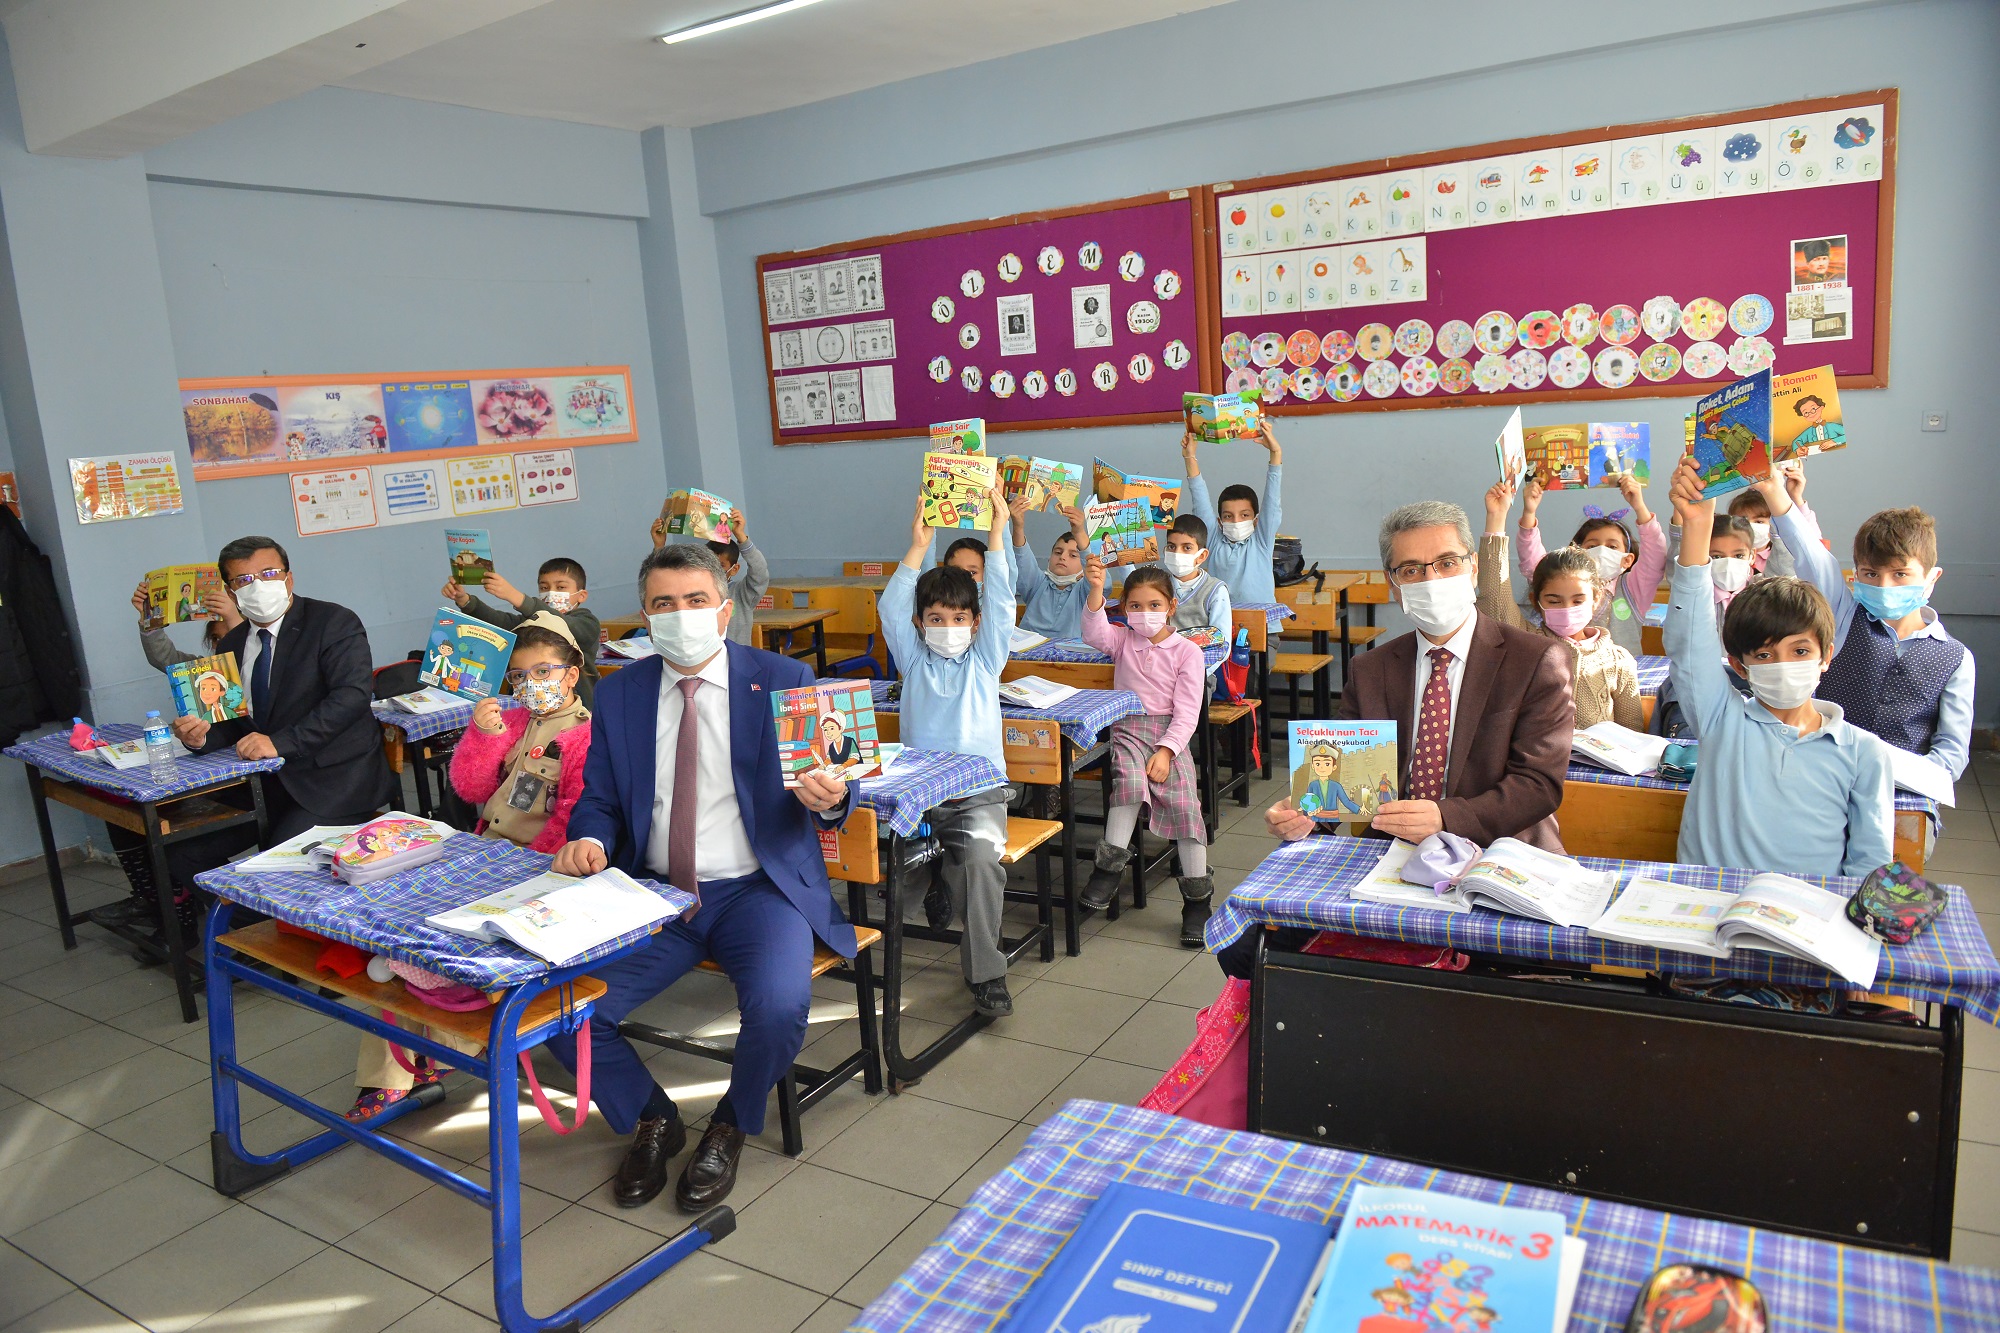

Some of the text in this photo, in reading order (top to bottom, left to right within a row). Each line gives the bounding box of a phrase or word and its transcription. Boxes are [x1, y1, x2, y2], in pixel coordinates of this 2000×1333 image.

[1778, 161, 1814, 177] Ö ö
[1836, 157, 1871, 171] R r
[1671, 173, 1704, 191] Ü ü
[1724, 170, 1758, 185] Y y
[1571, 188, 1602, 202] U u
[1620, 182, 1652, 196] T t
[1476, 201, 1507, 213] O o
[1521, 194, 1555, 208] M m
[1432, 206, 1462, 219] N n
[1304, 223, 1332, 238] A a
[1347, 219, 1373, 231] K k
[1227, 233, 1234, 245] E
[1266, 230, 1272, 241] L
[1350, 284, 1376, 296] B b
[1390, 279, 1399, 291] Z
[1796, 284, 1815, 292] 1881
[1823, 282, 1842, 290] 1938
[1268, 291, 1293, 304] D d
[1308, 287, 1333, 301] S s
[584, 379, 598, 388] YAZ
[1783, 372, 1818, 387] Roman
[1792, 386, 1802, 394] Ali
[192, 396, 248, 406] SONBAHAR
[325, 392, 341, 402] KIŞ
[1698, 382, 1754, 416] Roket Adam
[128, 456, 172, 466] ZAMAN ÖLÇÜSÜ
[1105, 510, 1122, 518] Yusuf
[191, 664, 212, 675] Çelebi
[779, 702, 818, 712] İbn-i Sina
[1296, 728, 1378, 738] Selçuklu'nun Tacı
[824, 833, 836, 842] İÇİN
[1356, 1216, 1554, 1260] MATEMATİK 3
[1418, 1233, 1513, 1260] DERS KİTABI
[1121, 1260, 1163, 1280] SINIF
[1164, 1269, 1234, 1296] DEFTERİ
